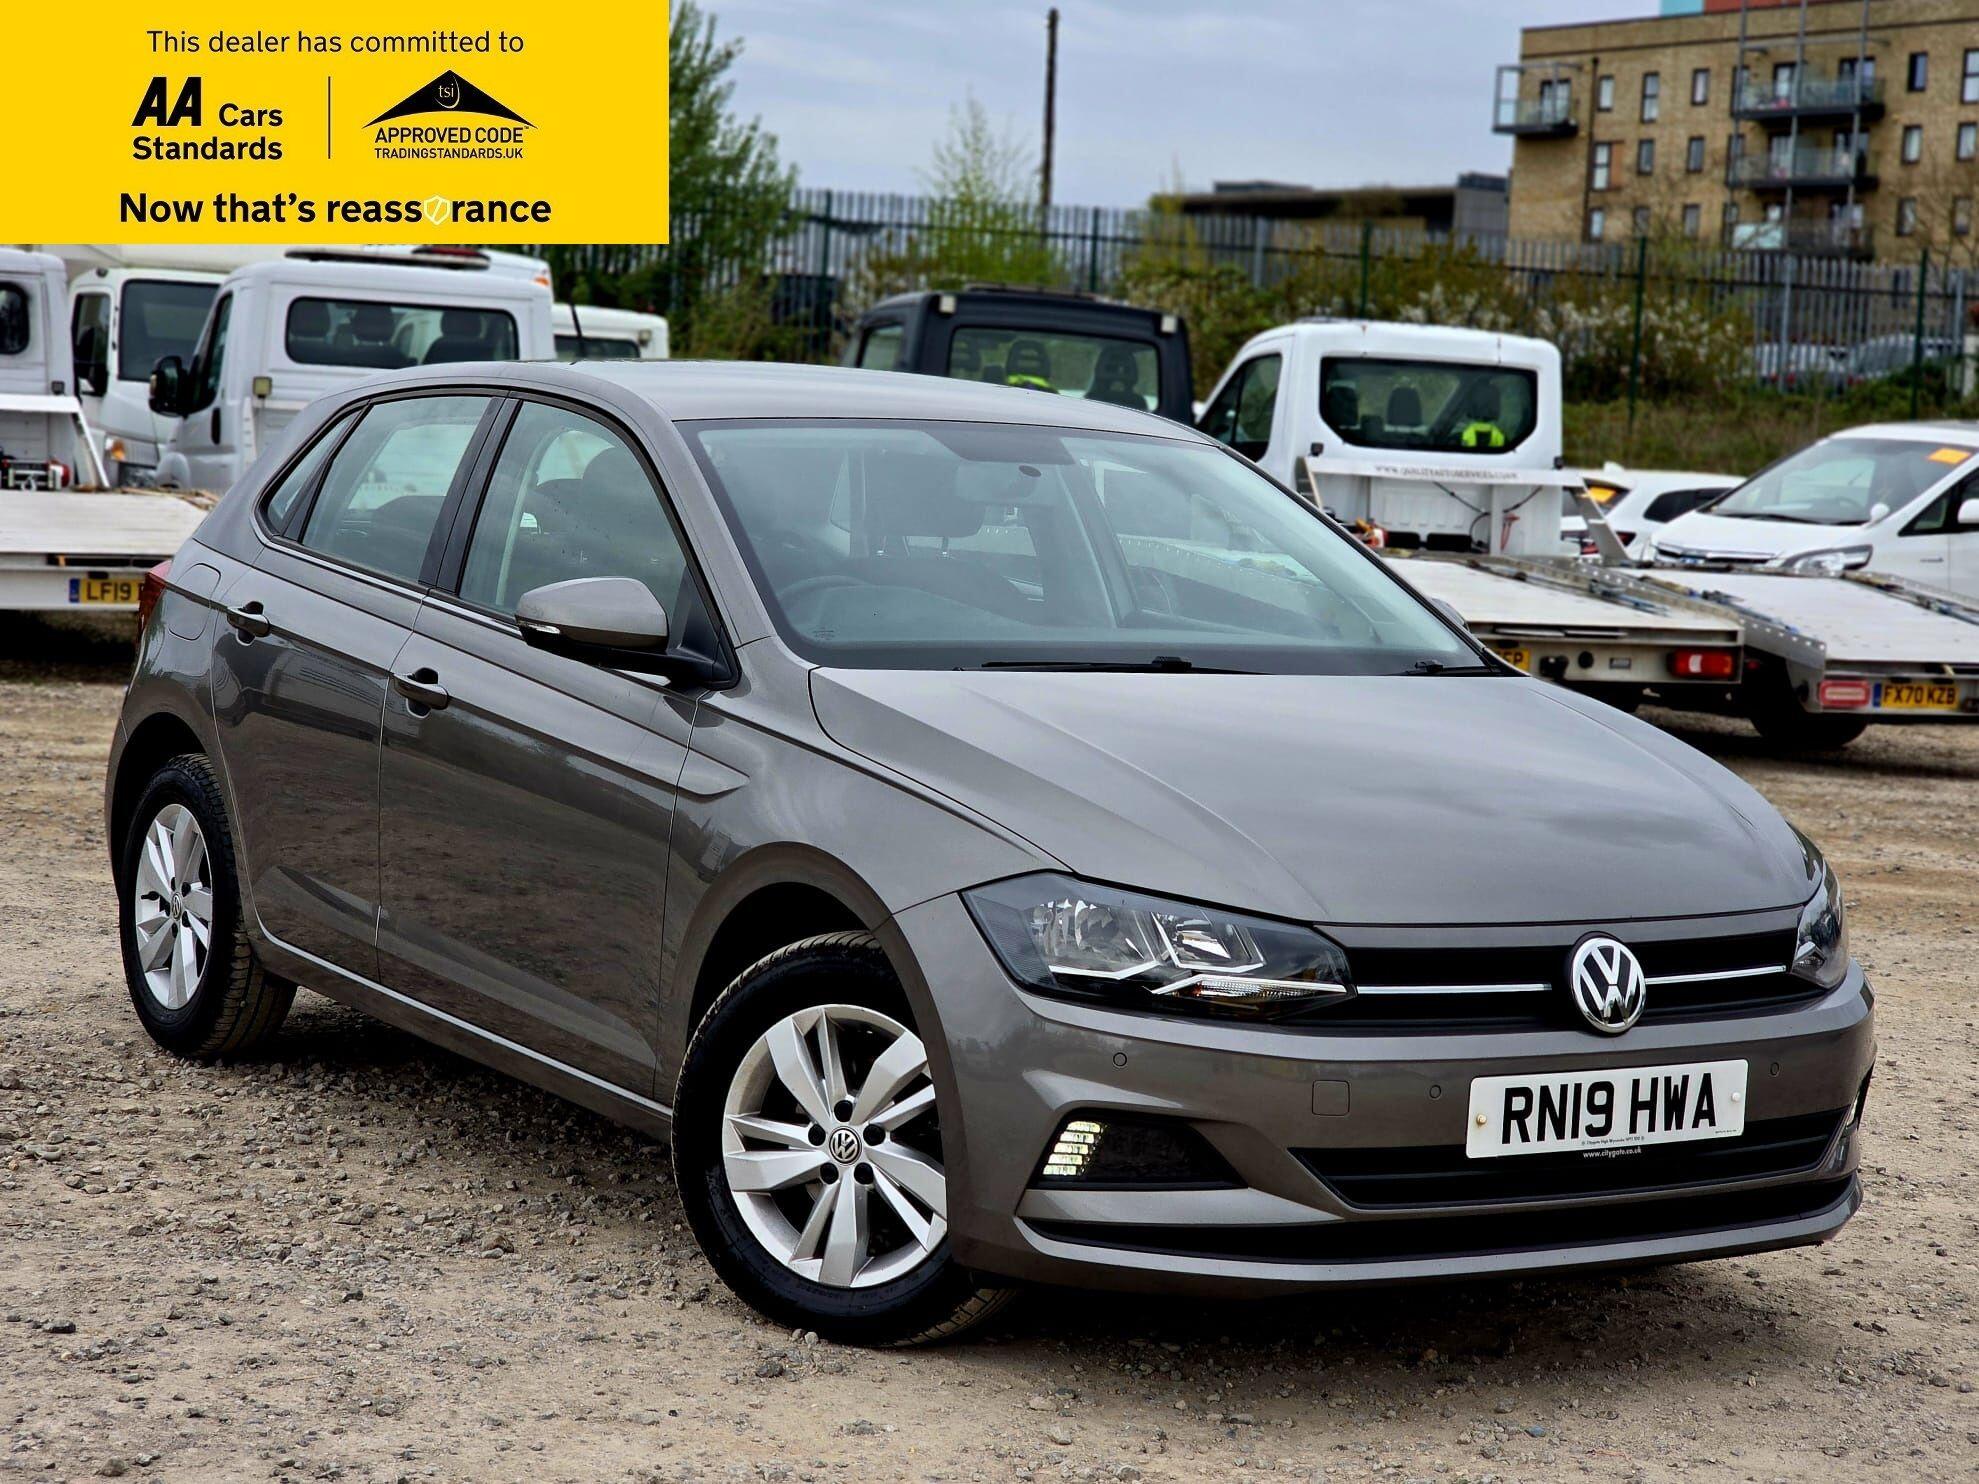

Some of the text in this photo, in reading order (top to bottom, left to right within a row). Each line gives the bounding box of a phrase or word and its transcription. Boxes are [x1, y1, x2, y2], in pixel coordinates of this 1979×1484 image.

[87, 582, 131, 600] LF19
[1884, 686, 1956, 705] FX70 KZB
[1502, 1073, 1716, 1144] RN19 HWA
